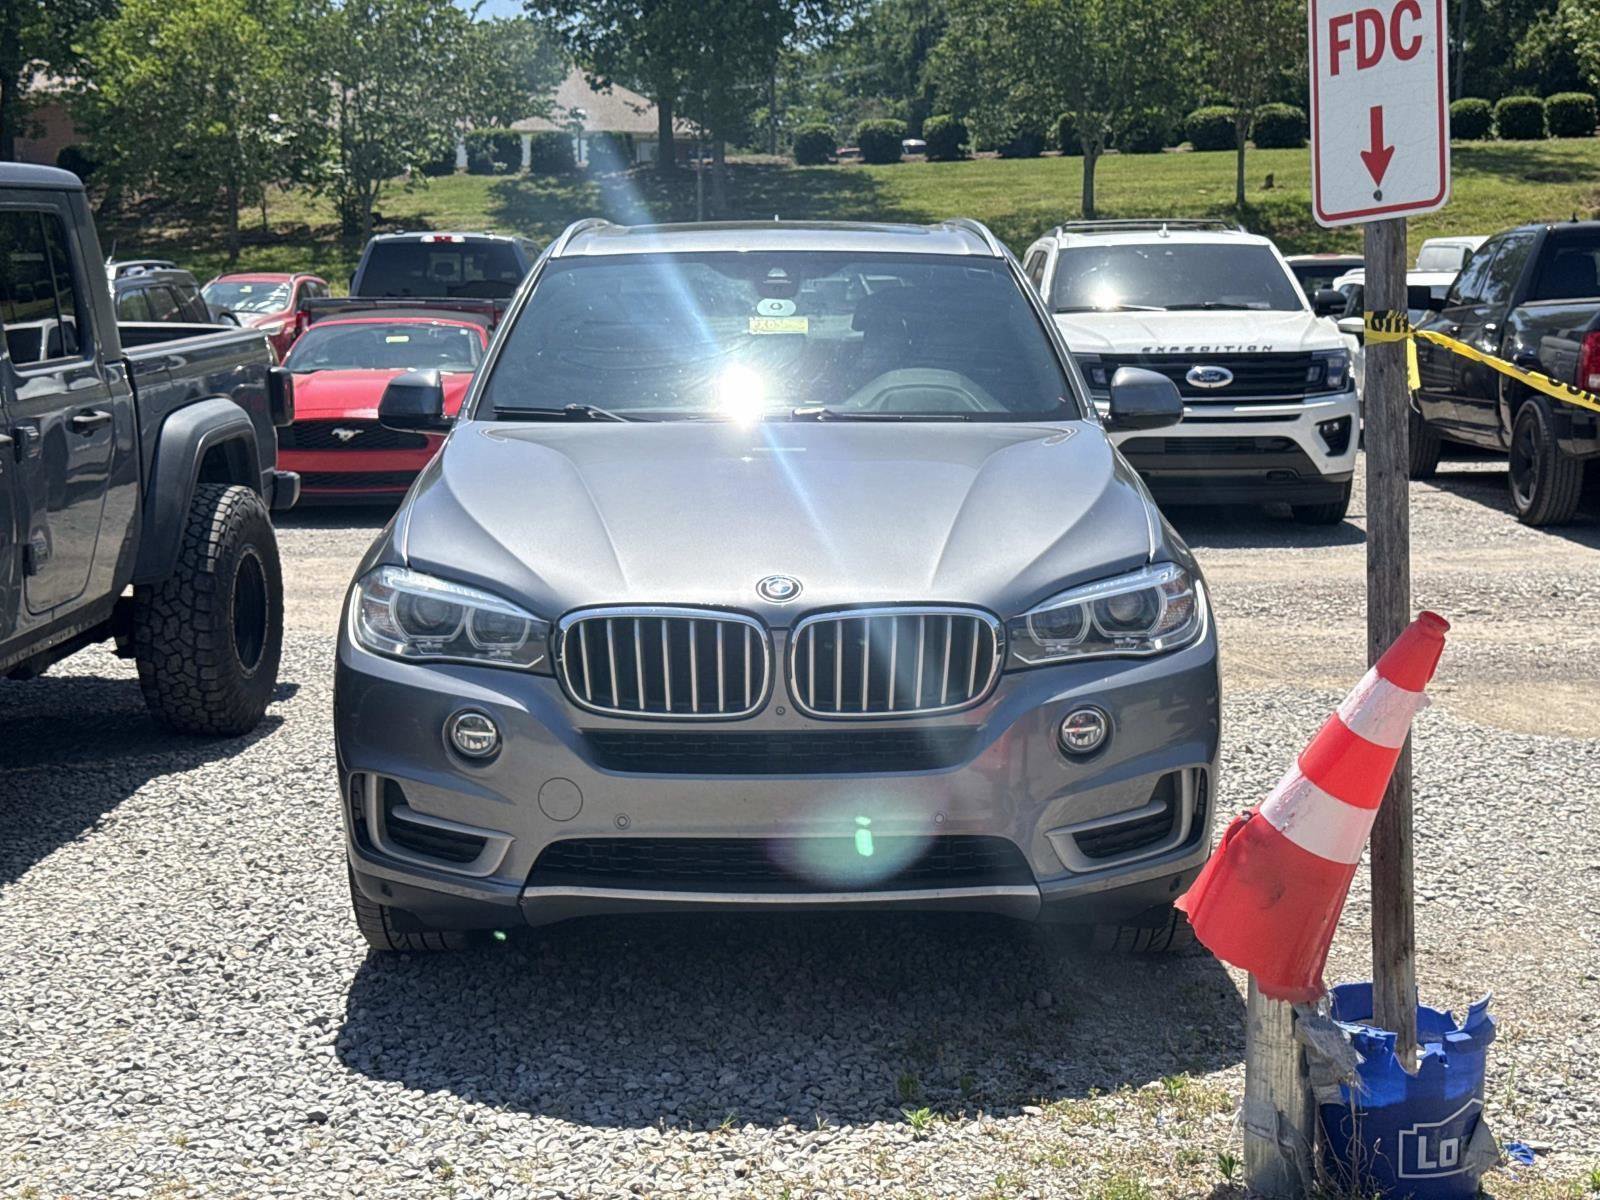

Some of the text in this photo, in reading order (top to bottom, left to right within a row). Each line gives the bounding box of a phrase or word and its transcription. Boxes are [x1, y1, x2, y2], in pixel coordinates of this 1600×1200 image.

[1329, 0, 1422, 77] FDC
[1141, 344, 1273, 354] EXPEDITION
[1417, 1135, 1461, 1169] LO
